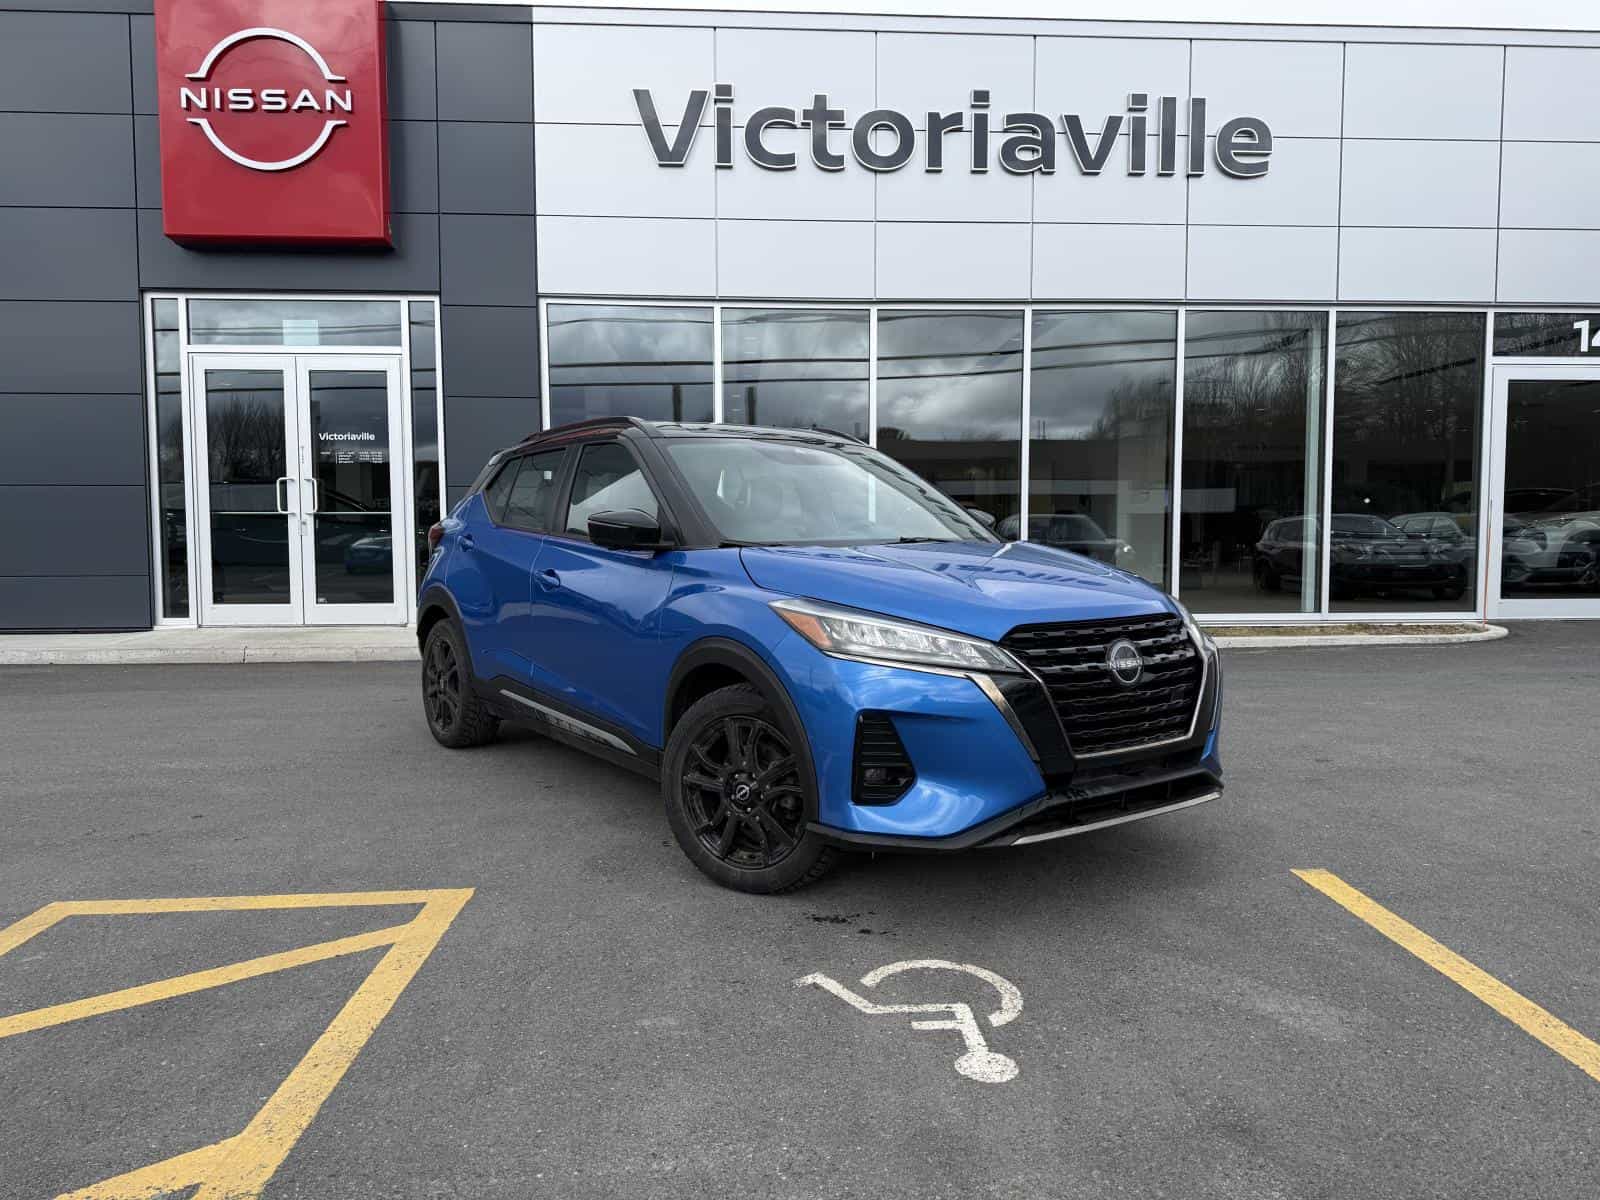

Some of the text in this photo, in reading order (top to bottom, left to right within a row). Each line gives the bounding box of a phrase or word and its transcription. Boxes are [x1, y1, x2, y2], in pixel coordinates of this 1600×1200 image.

[180, 87, 352, 111] NISSAN
[632, 83, 1273, 179] Victoriaville
[318, 431, 376, 441] Victoriaville
[1110, 657, 1143, 671] NISSAN
